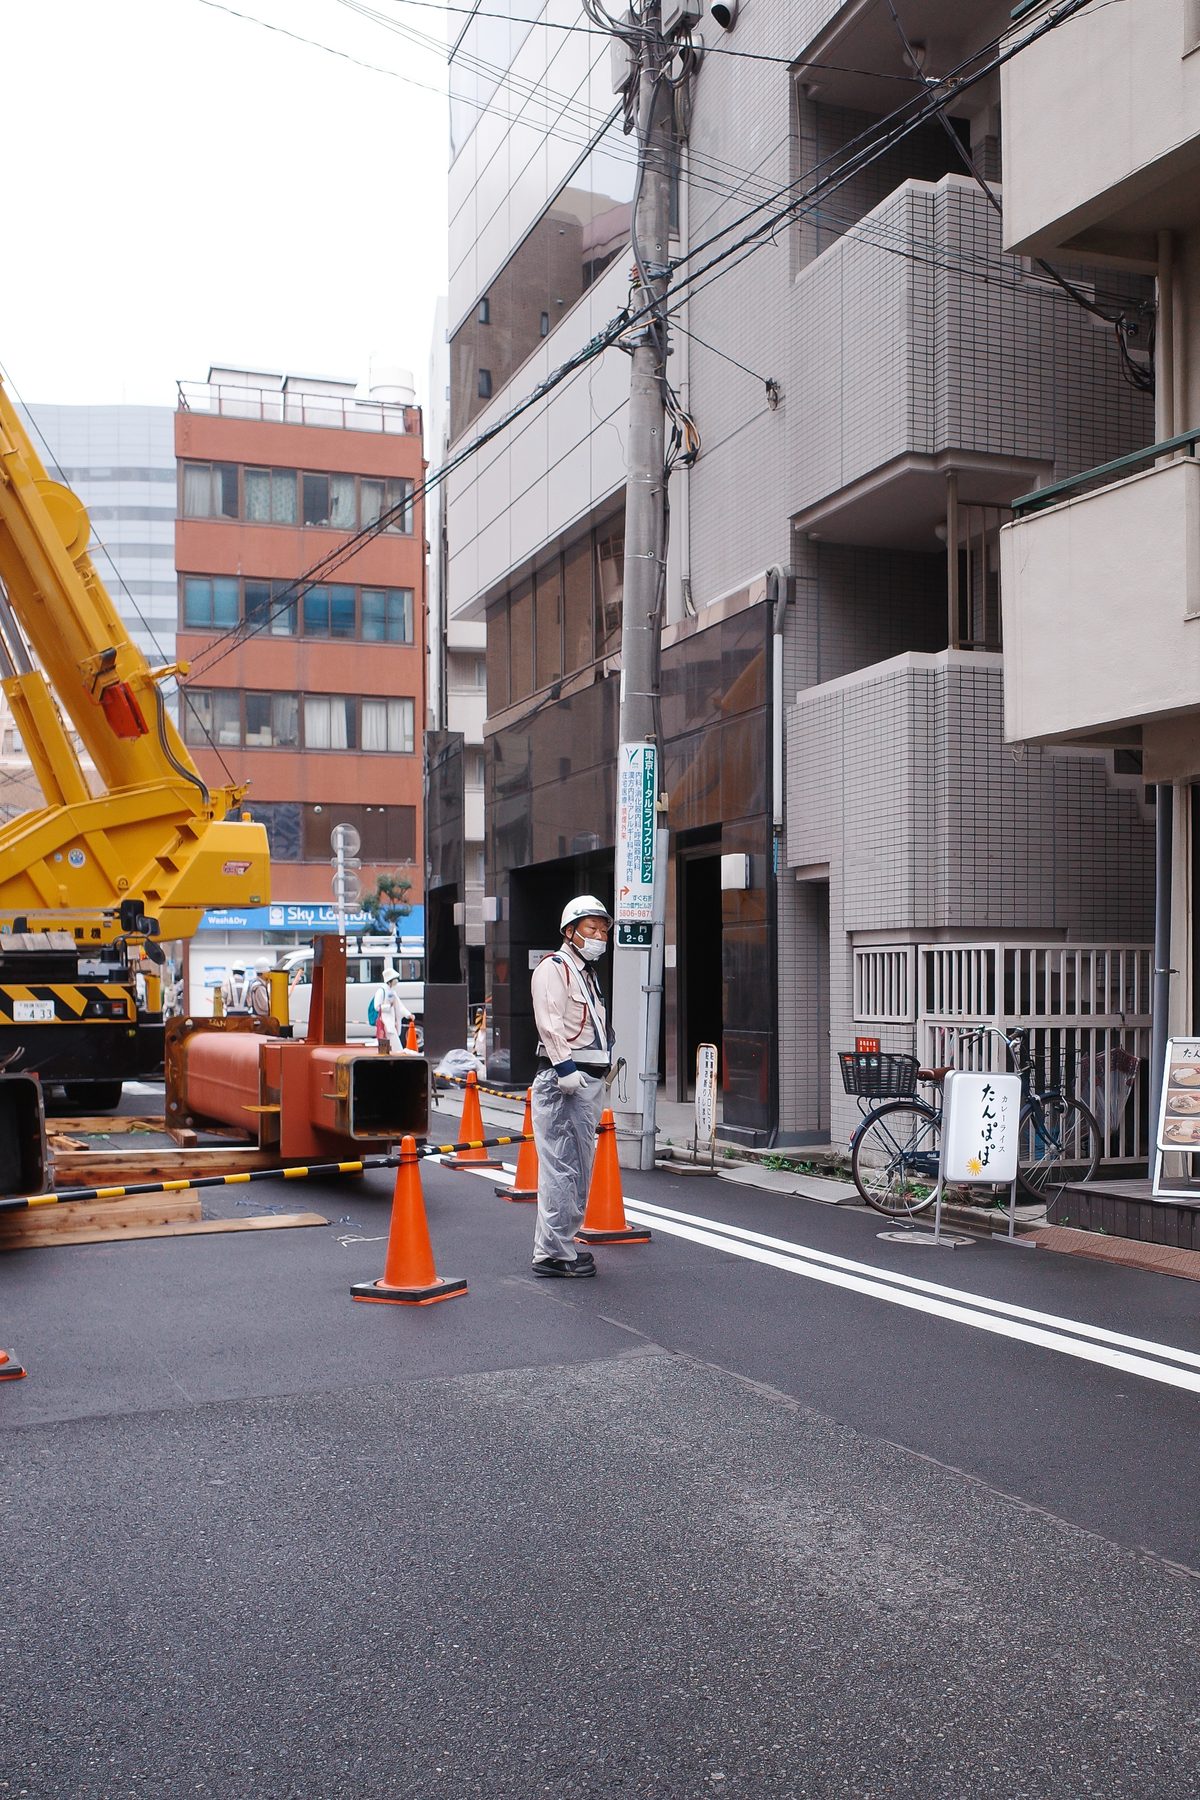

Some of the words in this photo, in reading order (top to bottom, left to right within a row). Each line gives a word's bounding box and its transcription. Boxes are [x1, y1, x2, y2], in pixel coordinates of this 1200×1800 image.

[643, 750, 654, 882] 東京トータルライフクリニック
[208, 916, 248, 926] Wash&Dry
[288, 907, 316, 925] Sky
[626, 934, 644, 943] 2-6
[978, 1083, 998, 1167] たんぽぽ
[998, 1095, 1008, 1153] カレーライス
